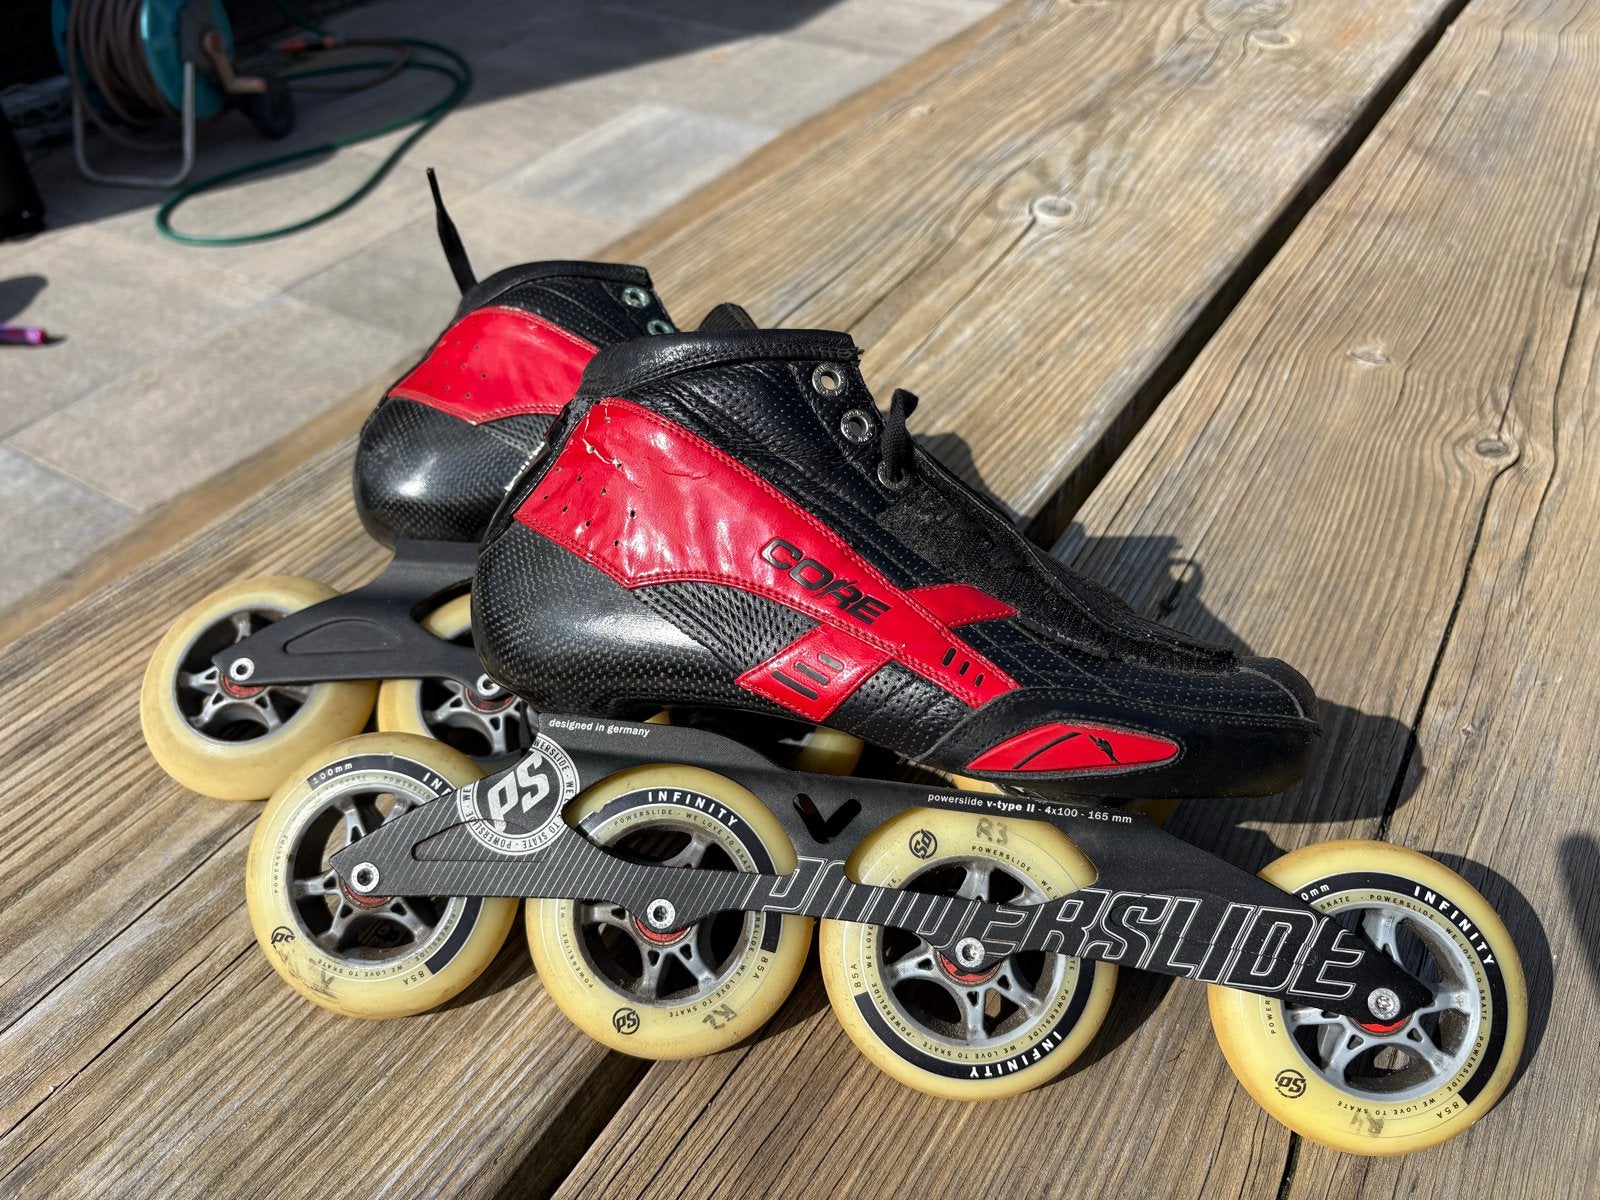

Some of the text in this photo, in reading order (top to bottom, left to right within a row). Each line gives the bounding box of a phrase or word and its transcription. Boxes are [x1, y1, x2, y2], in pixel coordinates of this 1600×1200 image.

[761, 537, 893, 626] CORE
[549, 718, 650, 738] designed in germany
[533, 739, 575, 794] WERSLIDE WE
[383, 775, 432, 800] POWERSLID
[487, 750, 550, 833] PS
[462, 788, 512, 849] POWERSLIDE WE
[648, 791, 739, 827] INFINITY
[927, 793, 984, 807] powerslide
[986, 800, 1023, 813] v-type
[1044, 805, 1078, 818] 4x100
[1087, 810, 1109, 821] 165
[1111, 813, 1133, 824] mm
[522, 820, 560, 849] TO SKATE
[614, 809, 753, 872] POWERSLIDE WE LOVE TO SKAT
[975, 817, 1009, 845] R3
[971, 845, 1052, 893] POWERSLIDE WE
[1301, 884, 1330, 901] 0mm
[415, 913, 456, 962] POWERSLIDE
[1413, 885, 1495, 965] INFINITY
[317, 959, 343, 974] SKATE
[392, 965, 404, 973] WE
[752, 956, 769, 979] 85A
[1320, 894, 1487, 1021] SKATE POWERSLIDE WE LOVE TO SKATE
[364, 970, 386, 978] LOVE
[402, 970, 425, 985] 85A
[737, 964, 746, 977] WE
[851, 963, 862, 988] 85A
[866, 925, 911, 1037] POWERSLIDE WE LOVE
[716, 980, 735, 998] LOVE
[669, 1005, 698, 1017] SKATE
[702, 998, 713, 1007] TO
[1028, 989, 1069, 1041] POWERSLIDE
[922, 1040, 951, 1056] SKATE
[969, 1031, 1062, 1078] INFINITY
[975, 1051, 998, 1059] LOVE
[1003, 1045, 1017, 1054] WE
[1446, 1035, 1484, 1092] POWERSLIDE
[1337, 1100, 1369, 1114] SKATE
[1393, 1105, 1418, 1115] LOVE
[1422, 1097, 1436, 1107] WE
[1436, 1101, 1460, 1119] 85A
